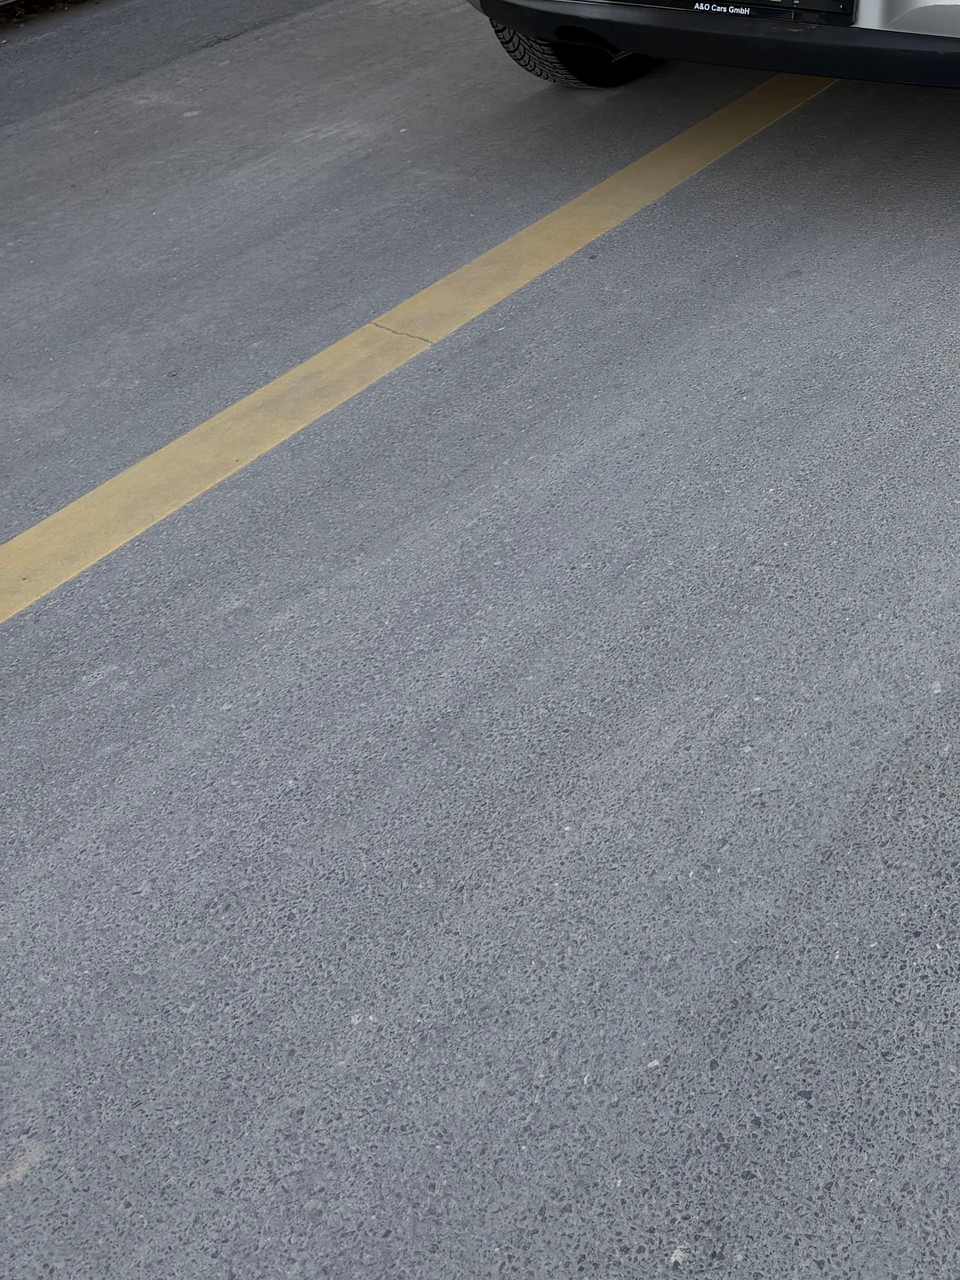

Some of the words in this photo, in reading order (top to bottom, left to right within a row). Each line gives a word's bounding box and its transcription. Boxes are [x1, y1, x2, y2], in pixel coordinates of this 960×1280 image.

[693, 2, 710, 11] A&O
[711, 4, 727, 13] Cars
[728, 6, 751, 15] GmbH
